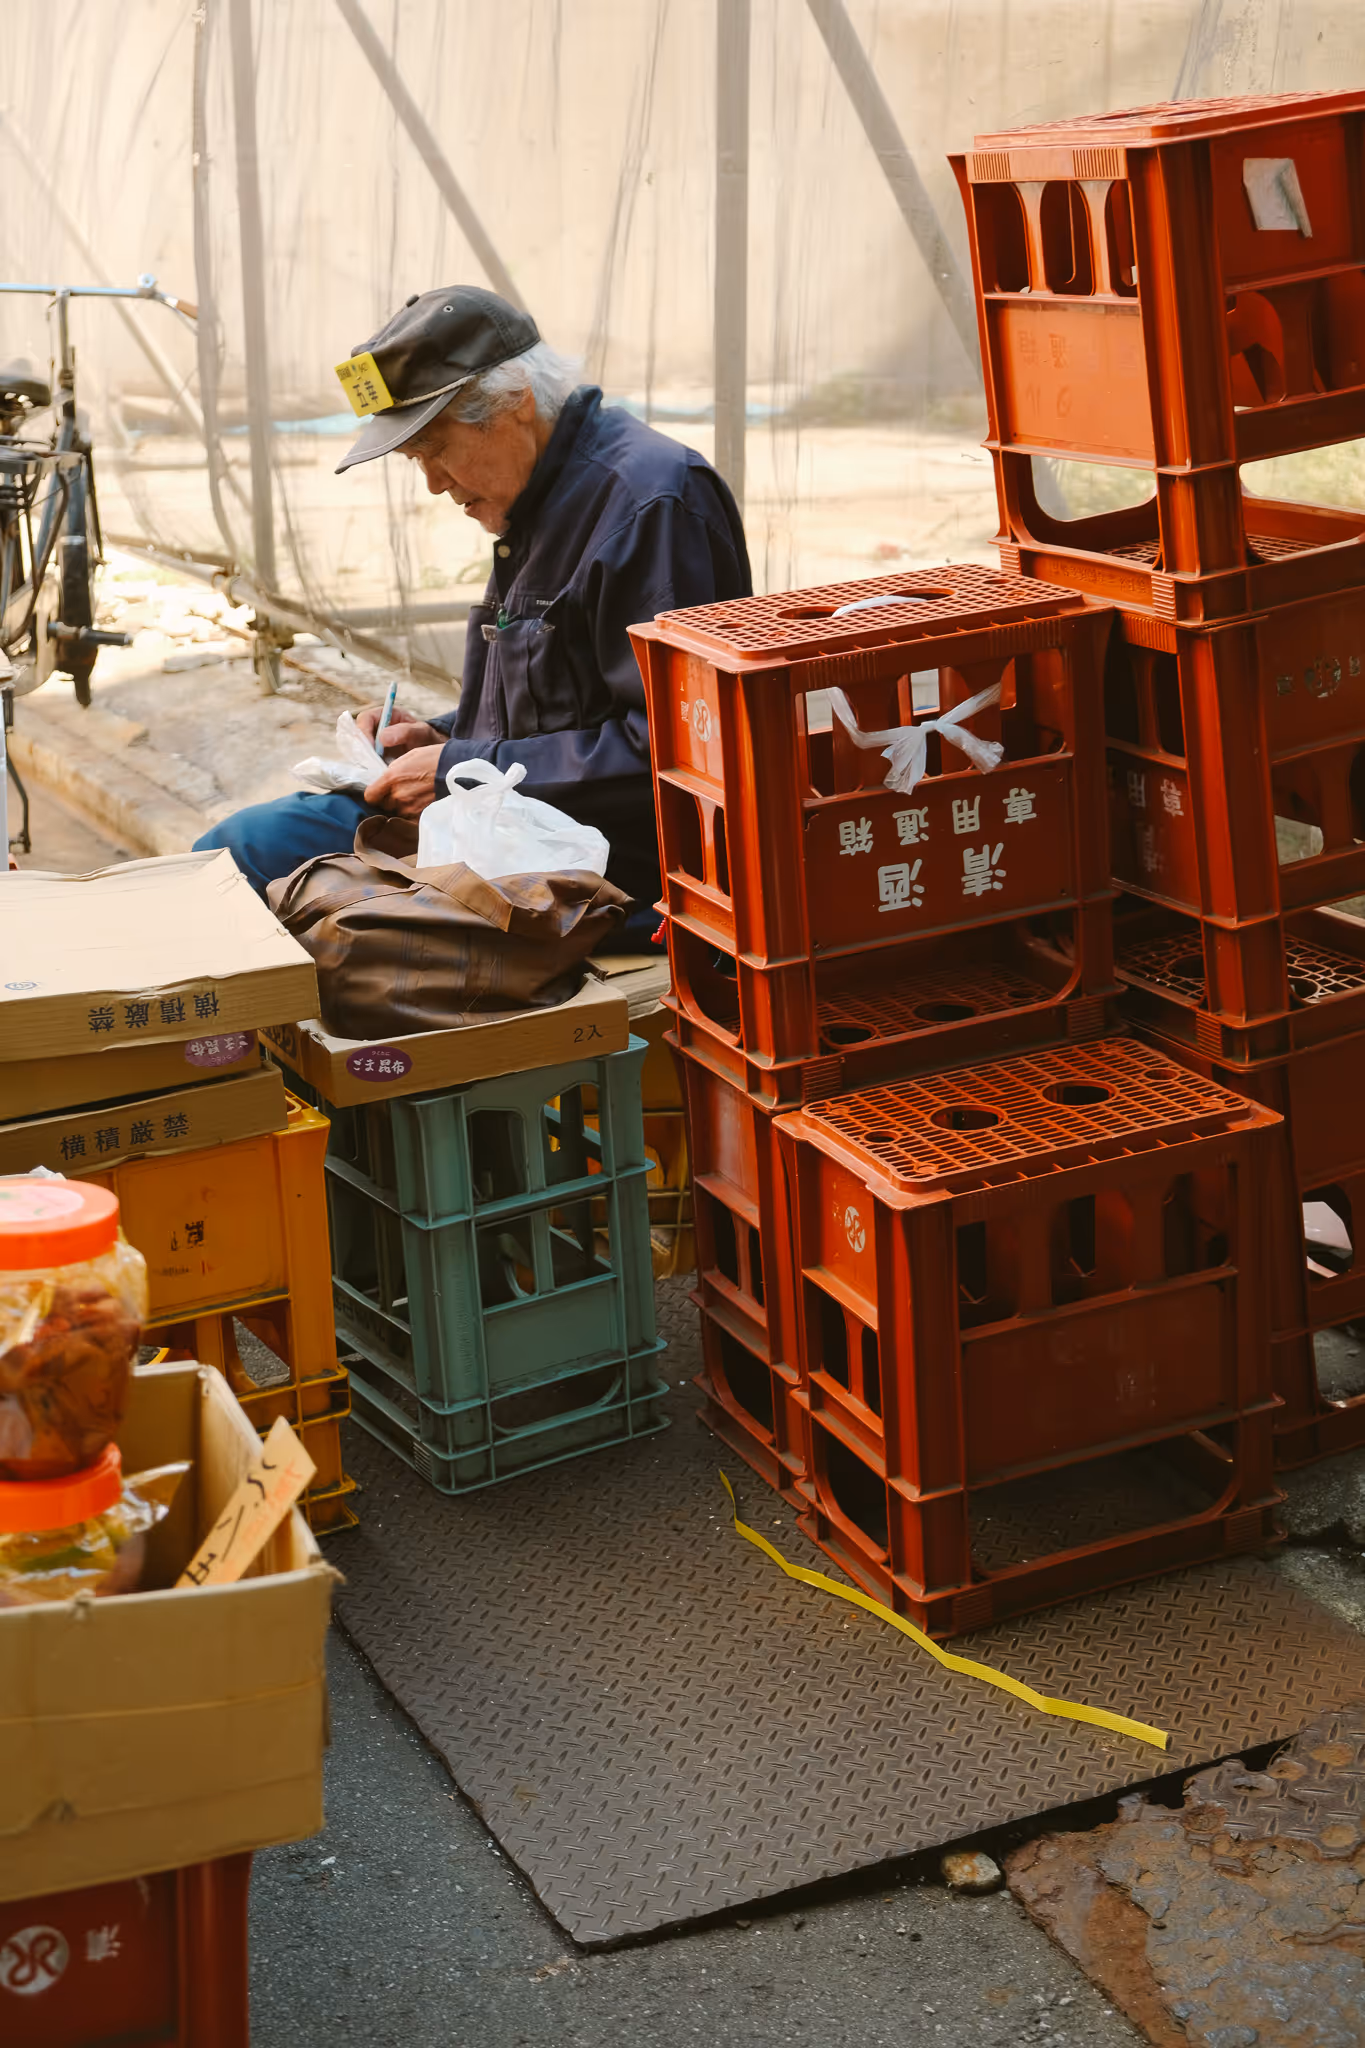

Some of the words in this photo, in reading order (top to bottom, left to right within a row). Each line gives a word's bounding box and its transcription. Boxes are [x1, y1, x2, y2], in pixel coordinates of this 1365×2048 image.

[838, 787, 1037, 856] 専用通箱
[877, 842, 1007, 913] 清酒
[88, 991, 220, 1033] 横積厳禁
[353, 1058, 405, 1075] ごま昆布
[60, 1112, 190, 1161] 横積厳禁
